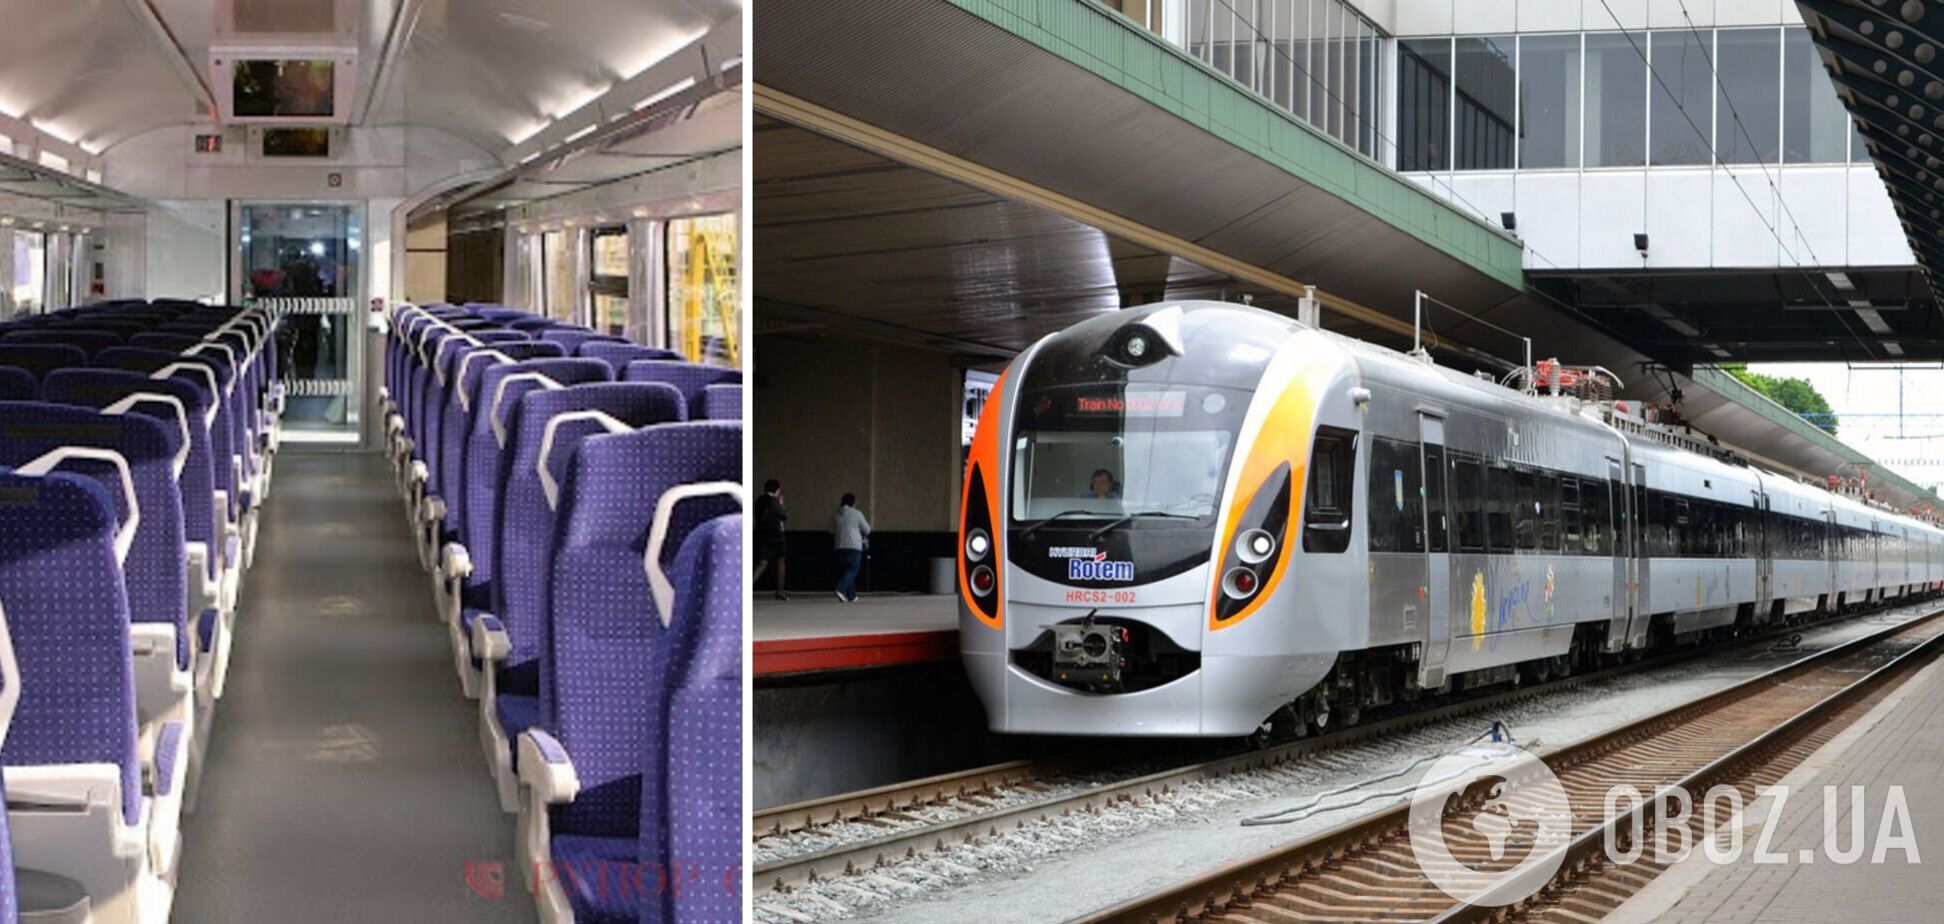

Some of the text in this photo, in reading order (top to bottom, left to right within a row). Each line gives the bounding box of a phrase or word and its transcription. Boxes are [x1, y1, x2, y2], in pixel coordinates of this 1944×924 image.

[1077, 397, 1107, 411] Train
[1069, 555, 1134, 580] Rotem
[1066, 590, 1136, 603] HRCS2-002
